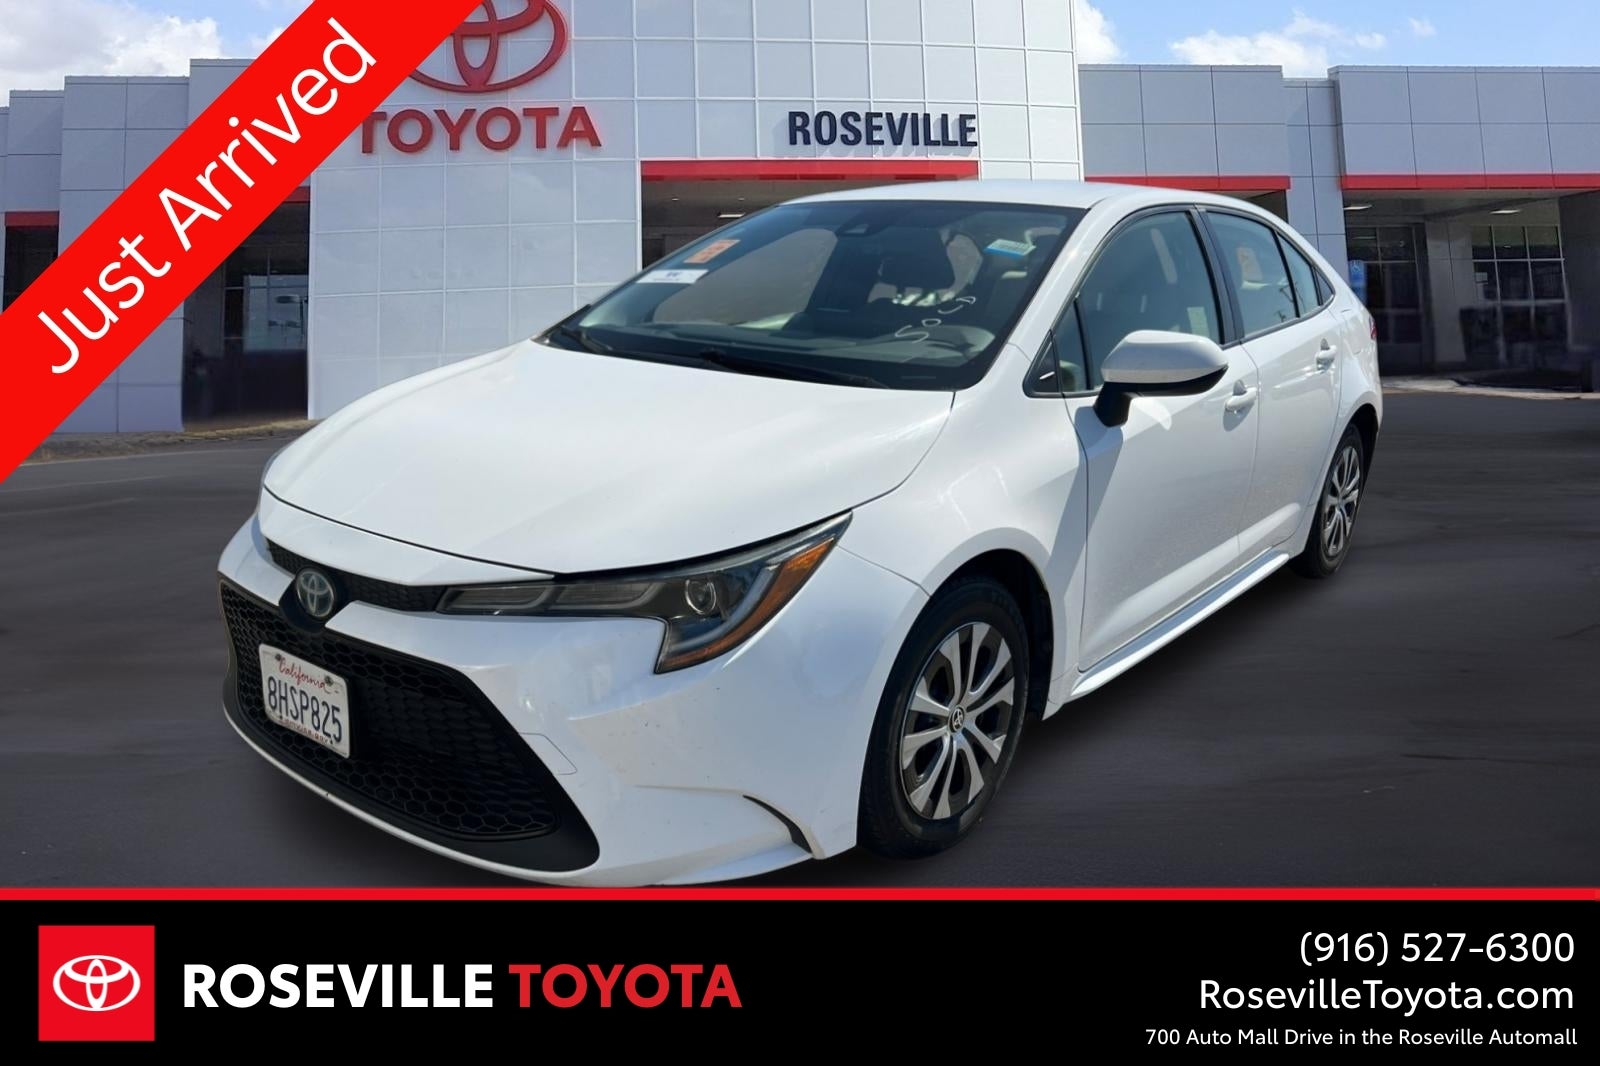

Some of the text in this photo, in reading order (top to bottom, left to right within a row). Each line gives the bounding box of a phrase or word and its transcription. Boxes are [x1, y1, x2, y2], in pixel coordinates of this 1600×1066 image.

[361, 106, 602, 153] TOYOTA
[788, 111, 978, 147] ROSEVILLE
[279, 656, 332, 694] California
[268, 676, 342, 743] 8HSP825
